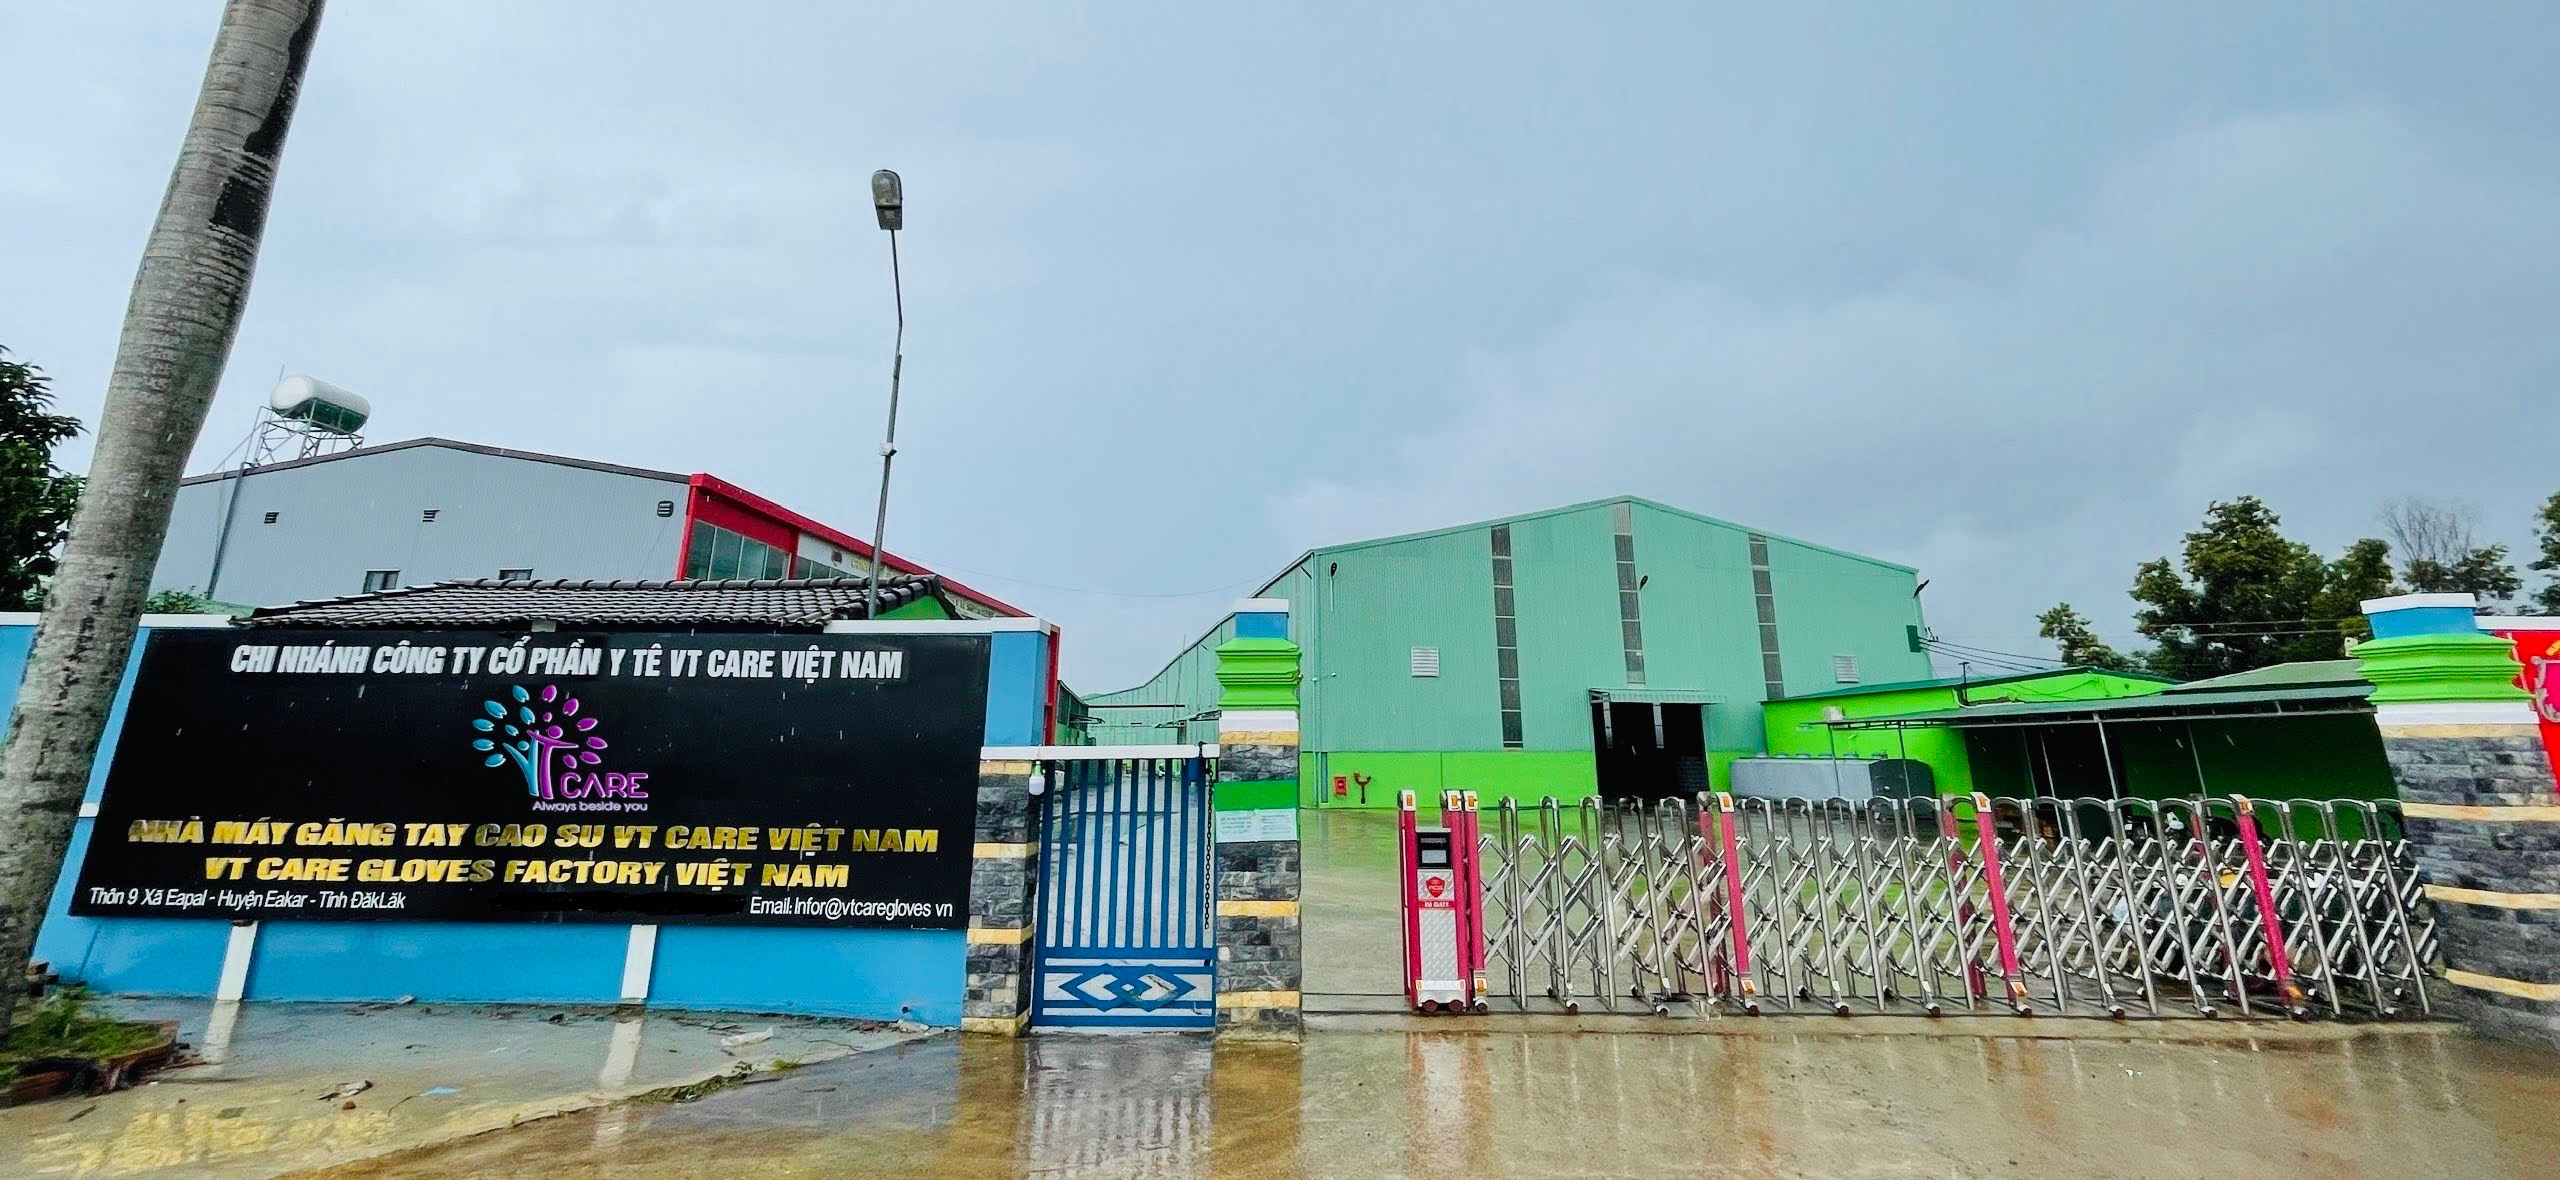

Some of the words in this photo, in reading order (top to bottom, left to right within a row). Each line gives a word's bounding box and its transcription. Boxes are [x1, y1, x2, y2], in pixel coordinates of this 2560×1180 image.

[230, 644, 279, 673] CHI
[277, 640, 370, 673] NHÁNH
[372, 640, 446, 674] CÔNG
[452, 647, 486, 674] TY
[488, 635, 532, 674] CỔ
[529, 638, 602, 675] PHẦN
[610, 648, 626, 676] Y
[669, 650, 702, 677] VT
[707, 651, 774, 678] CARE
[781, 645, 836, 684] VIỆT
[840, 651, 903, 679] NAM
[560, 772, 649, 798] CARE
[532, 801, 577, 813] Always
[579, 801, 622, 812] beside
[625, 803, 648, 813] you
[211, 817, 293, 845] MÁY
[296, 818, 396, 846] GĂNG
[404, 823, 471, 847] TAY
[475, 824, 548, 847] CAO
[554, 824, 604, 848] SU
[614, 826, 658, 849] VT
[664, 827, 759, 851] CARE
[768, 822, 845, 856] VIỆT
[852, 829, 938, 853] NAM
[205, 857, 252, 880] VT
[255, 857, 352, 881] CARE
[357, 858, 495, 883] GLOVES
[504, 860, 667, 885] FACTORY
[676, 857, 751, 891] VIỆT
[760, 865, 850, 888] NAM
[89, 887, 125, 905] Thôn
[126, 887, 139, 905] 9
[140, 888, 164, 906] Xã
[164, 888, 208, 910] Eapal
[217, 889, 265, 911] Huyện
[263, 891, 309, 909] Eakar
